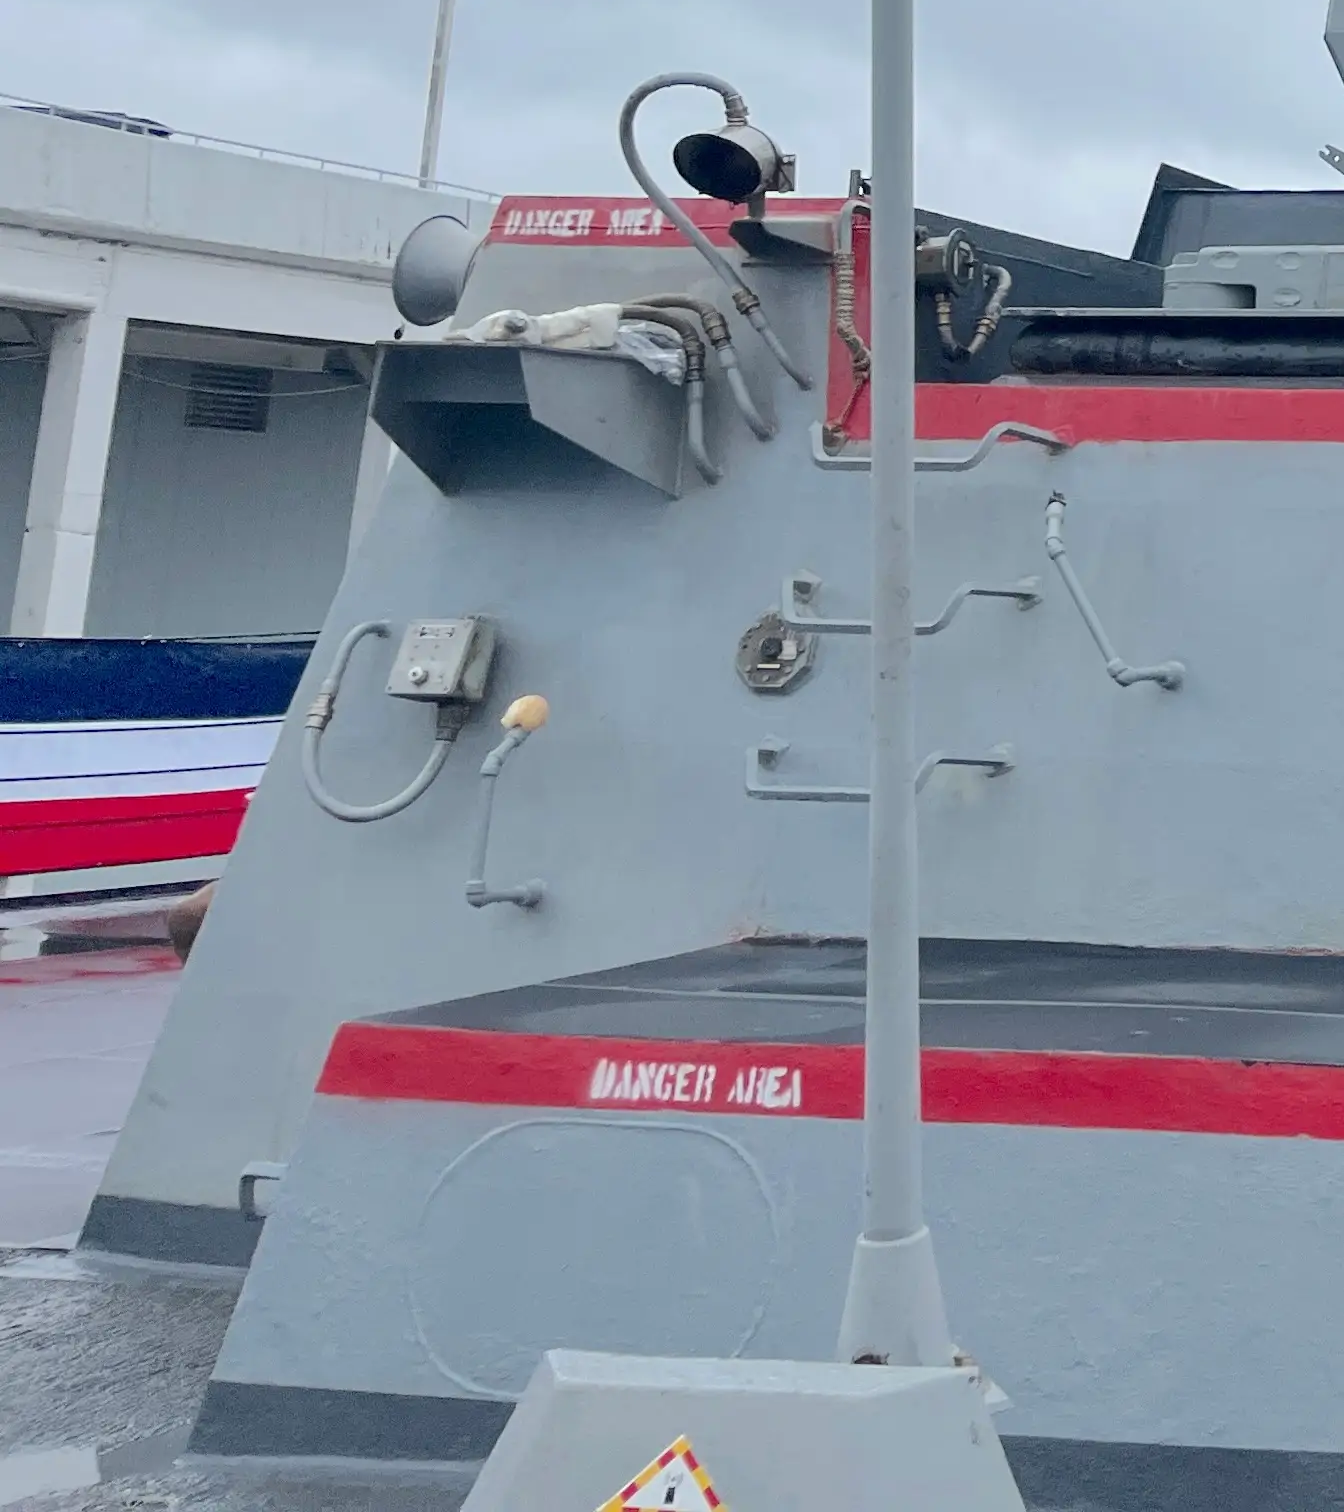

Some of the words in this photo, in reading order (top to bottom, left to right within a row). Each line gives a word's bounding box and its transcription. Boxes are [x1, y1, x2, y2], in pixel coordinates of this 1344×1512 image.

[504, 209, 594, 237] DANGER
[606, 208, 664, 236] AREA
[589, 1058, 717, 1103] DANGER
[727, 1066, 802, 1108] AREA
